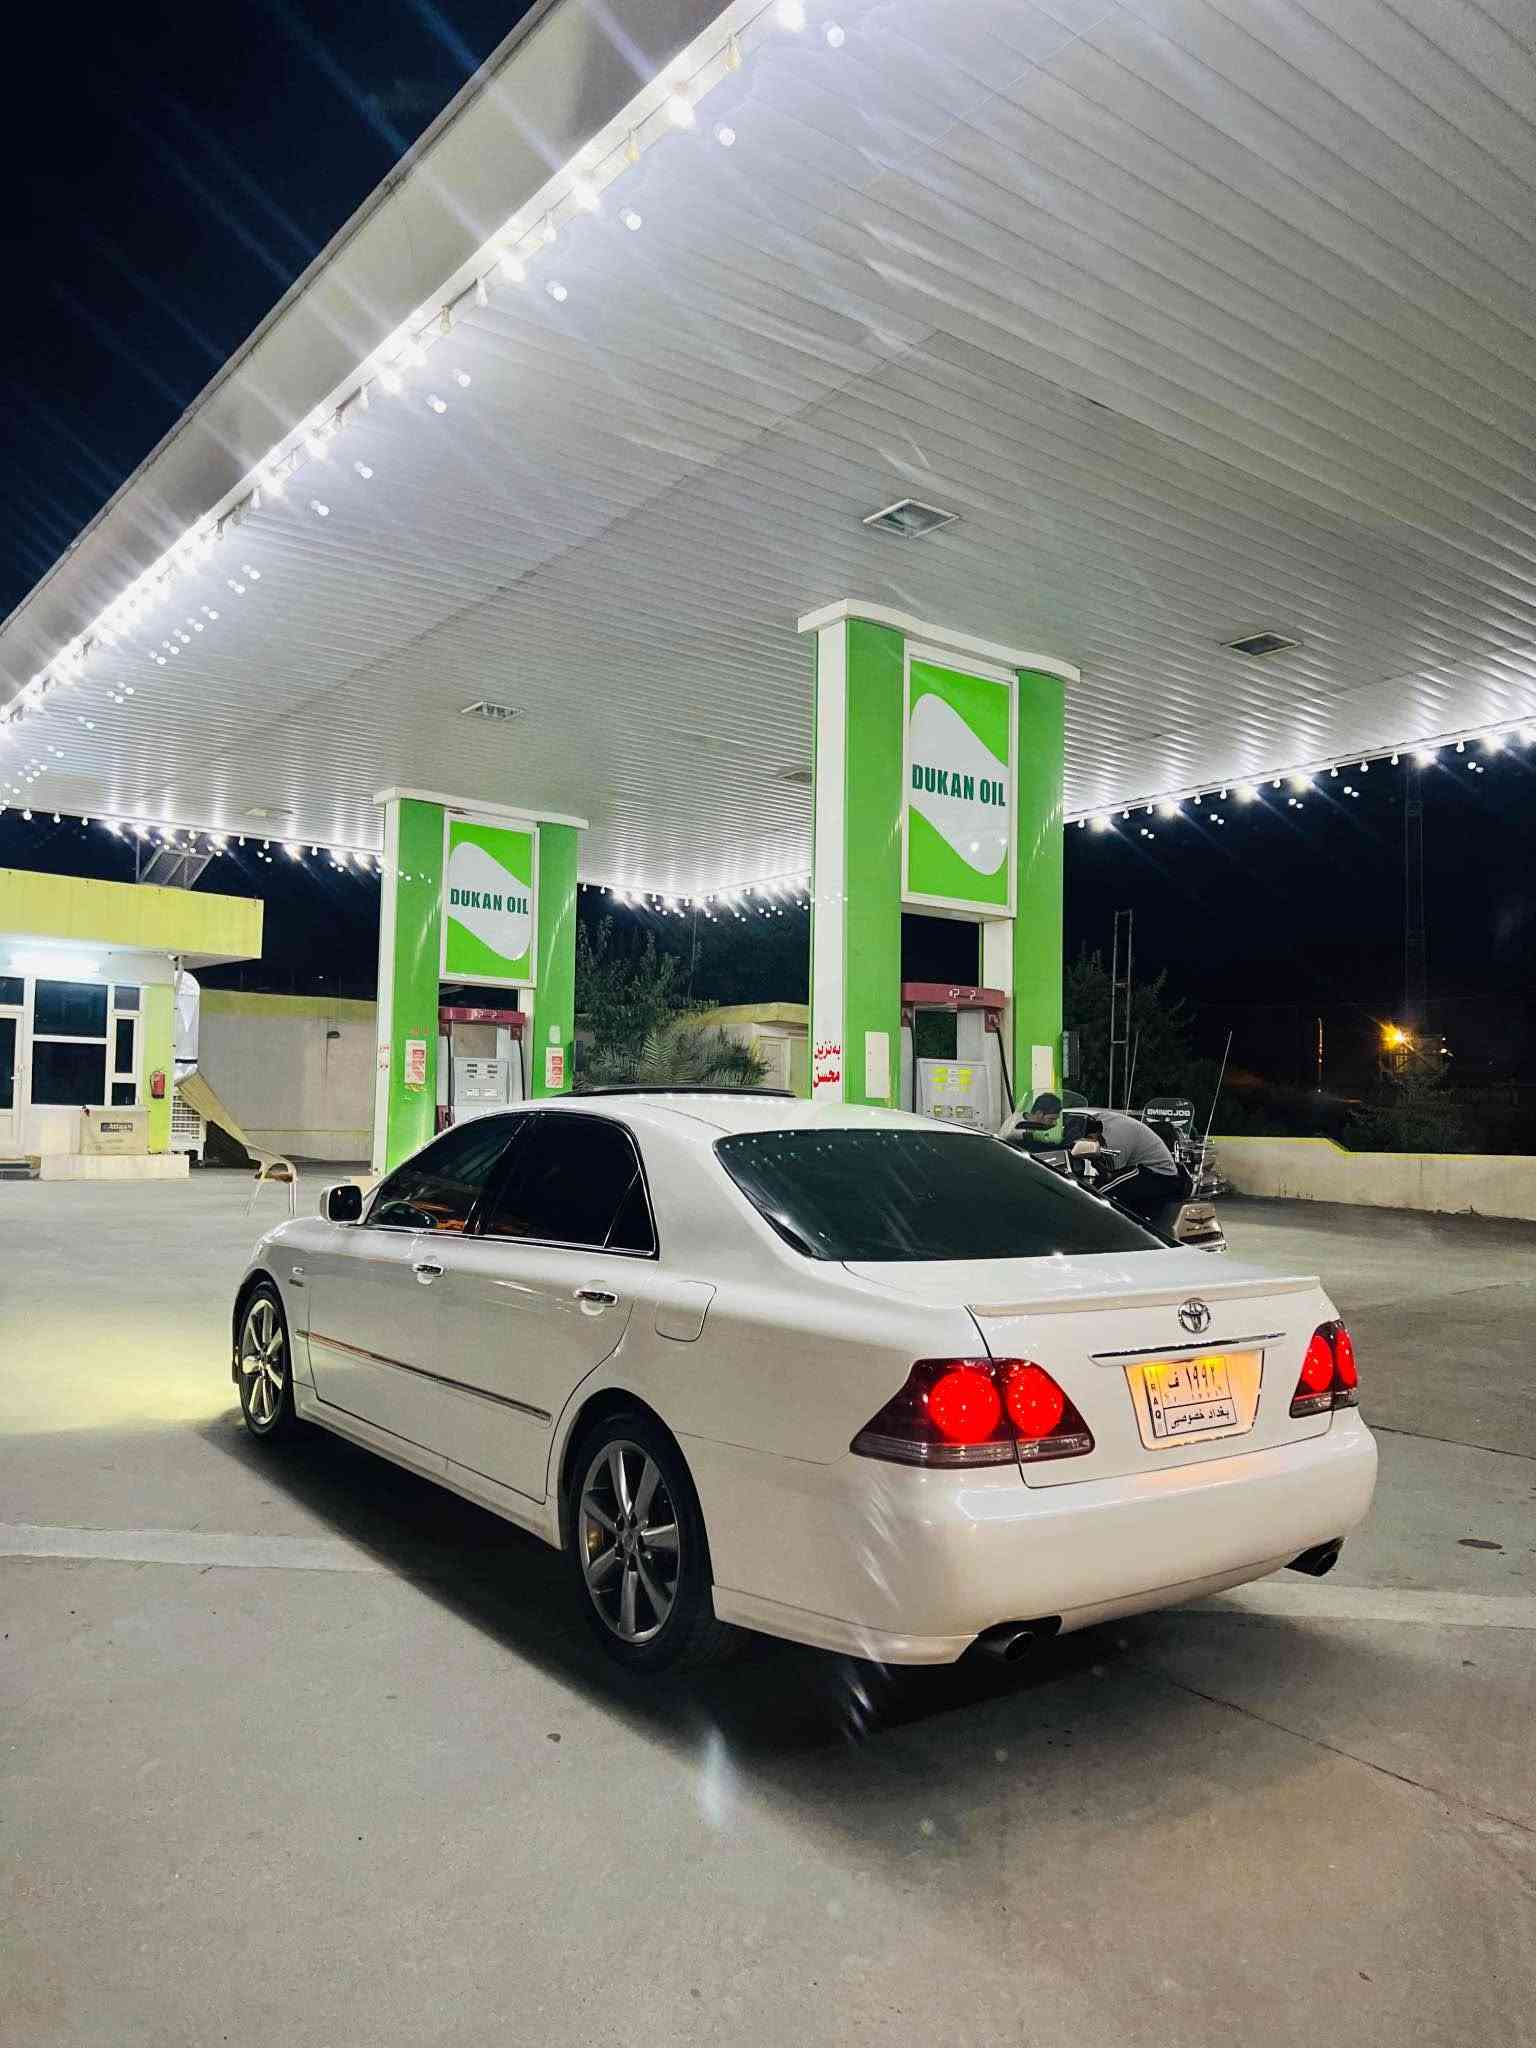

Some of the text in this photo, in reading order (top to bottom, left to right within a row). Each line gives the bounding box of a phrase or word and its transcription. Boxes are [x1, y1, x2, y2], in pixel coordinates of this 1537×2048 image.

[912, 763, 1006, 807] DUKAN OIL
[450, 888, 529, 915] DUKAN OIL
